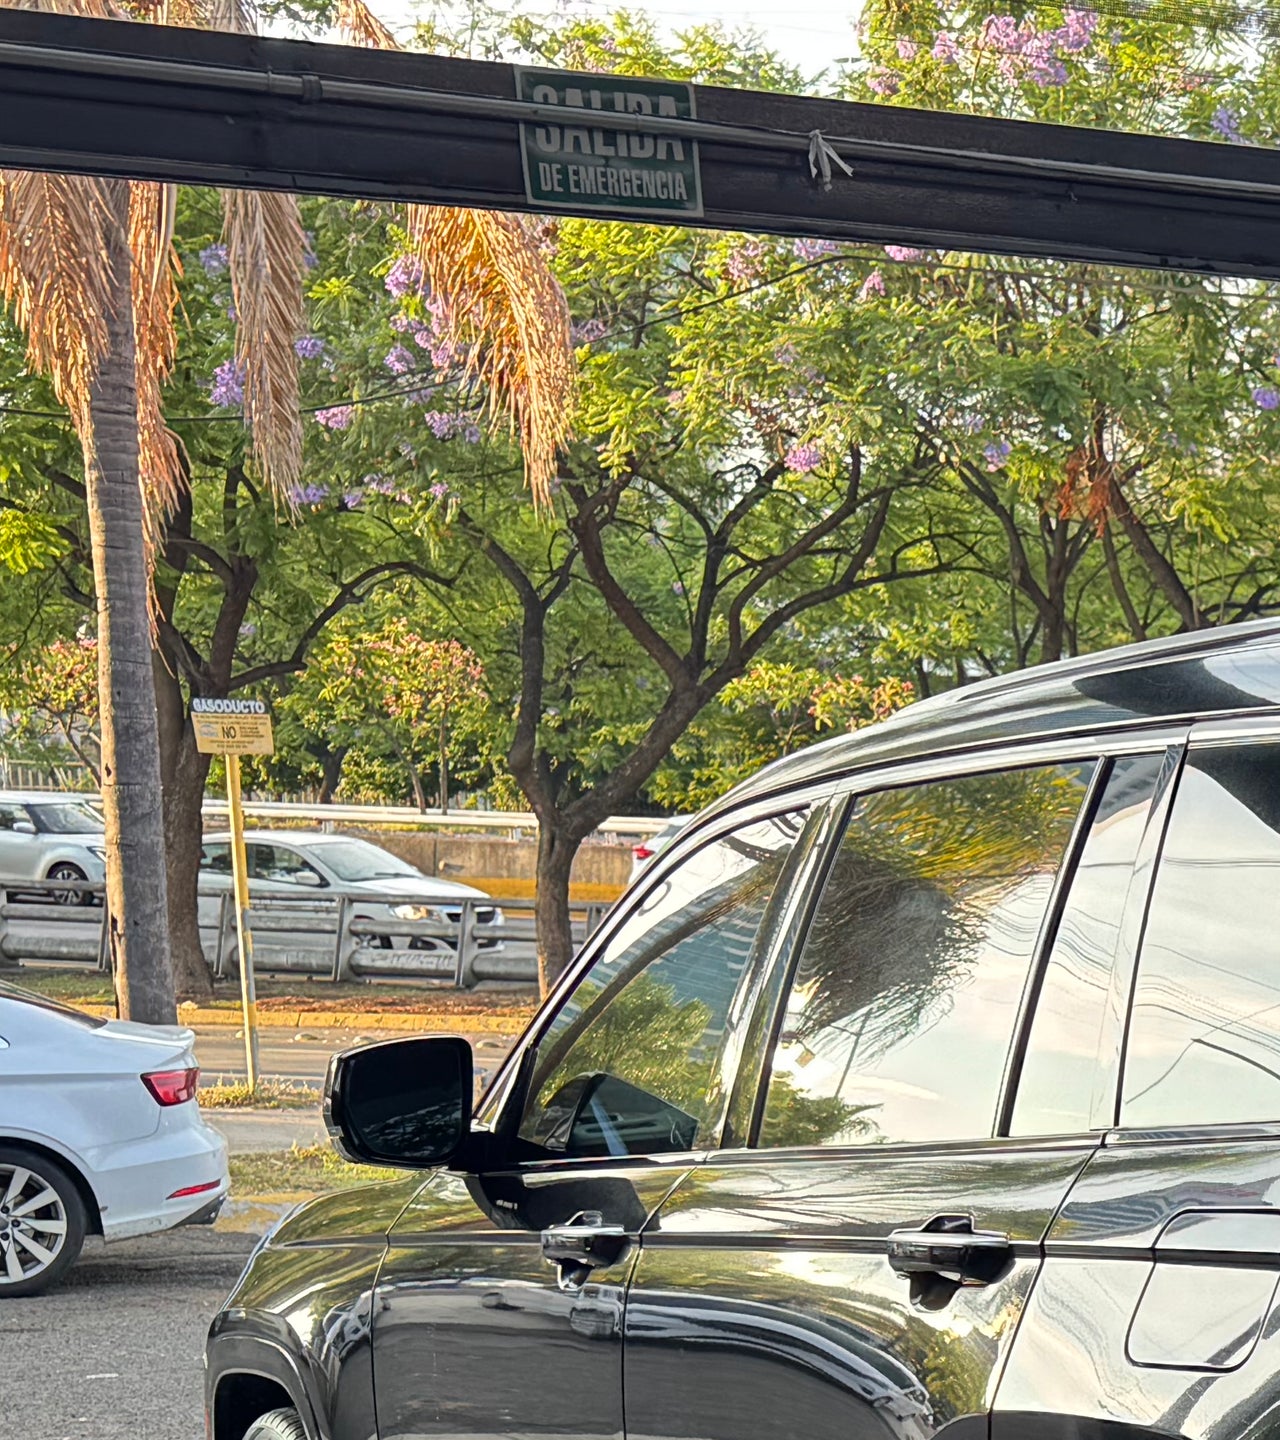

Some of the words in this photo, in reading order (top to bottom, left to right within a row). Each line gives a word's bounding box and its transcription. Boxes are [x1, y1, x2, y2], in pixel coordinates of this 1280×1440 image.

[532, 84, 685, 162] SALIDA
[538, 162, 564, 193] DE
[567, 164, 689, 201] EMERGENCIA
[192, 697, 266, 714] GASODUCTO
[221, 725, 237, 739] NO
